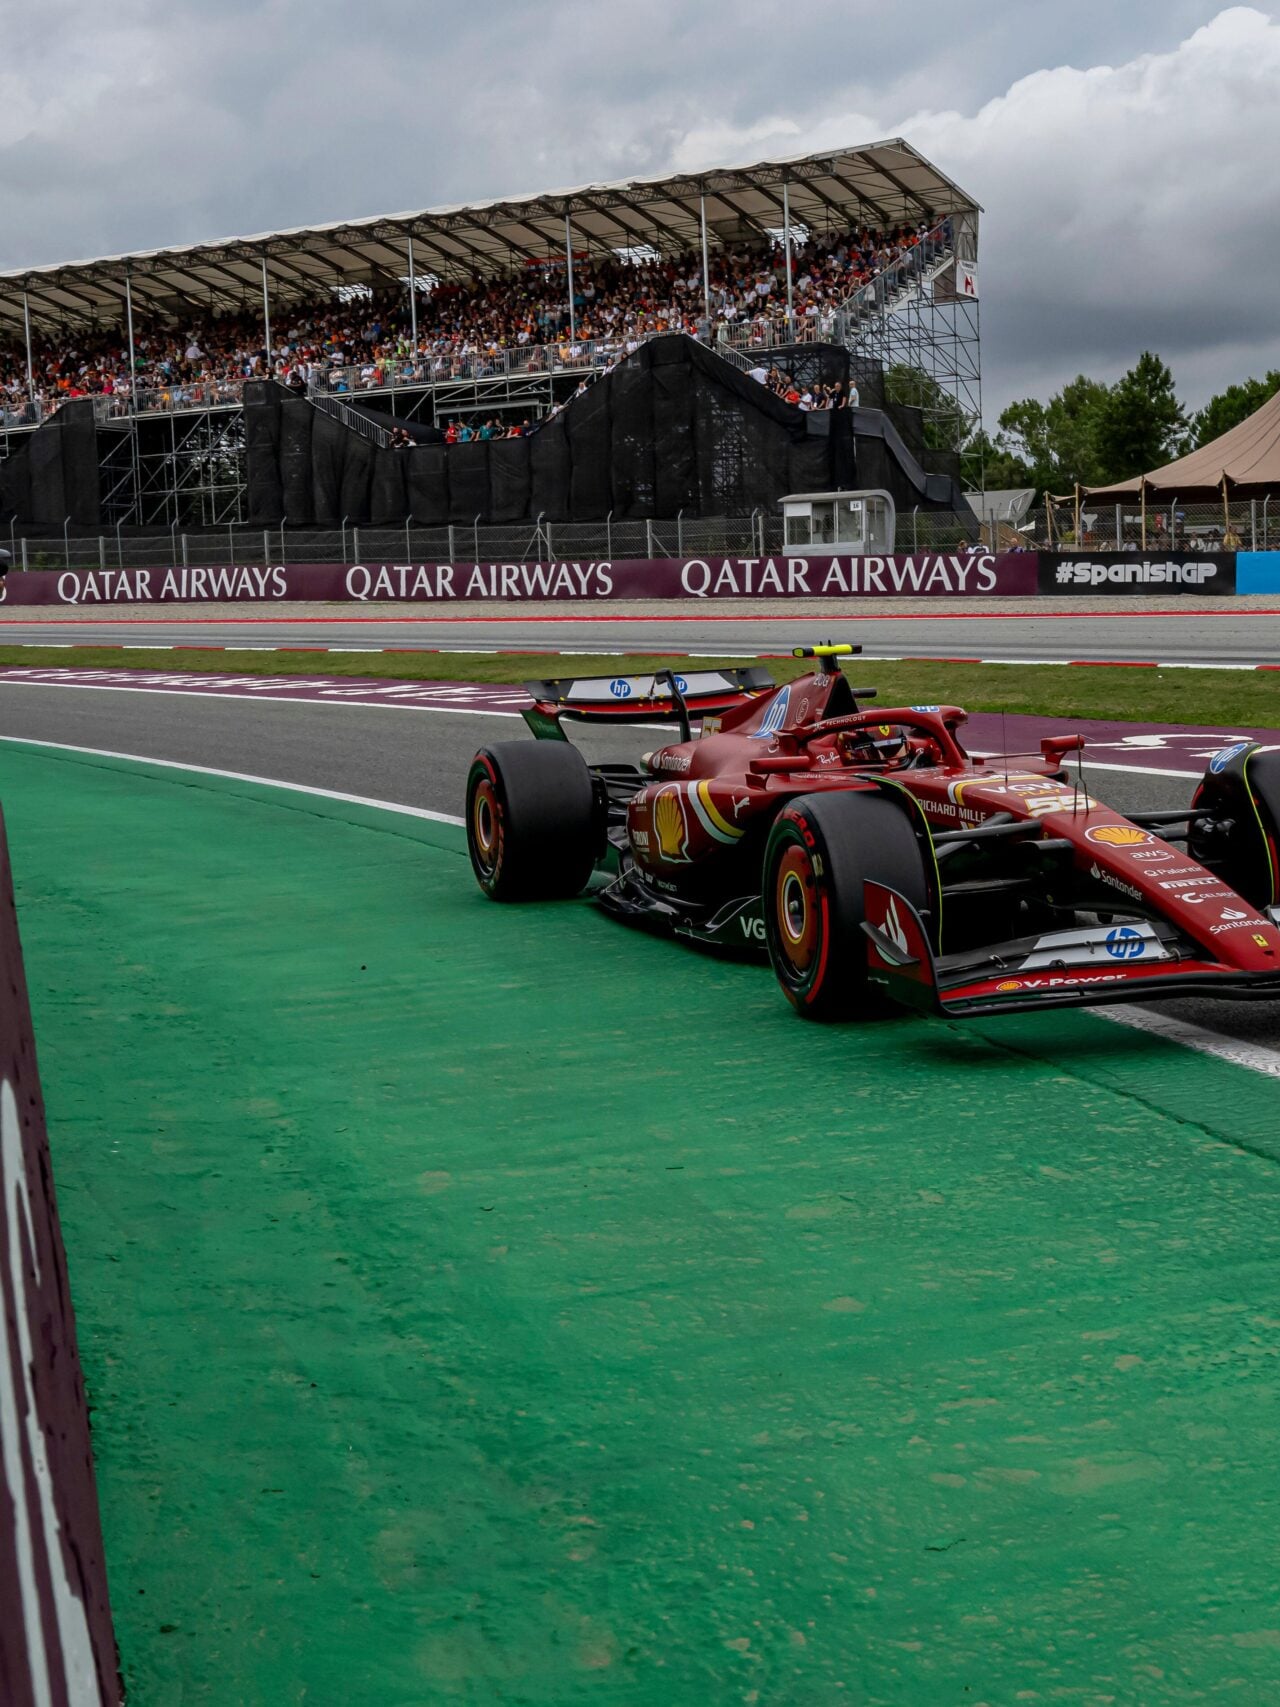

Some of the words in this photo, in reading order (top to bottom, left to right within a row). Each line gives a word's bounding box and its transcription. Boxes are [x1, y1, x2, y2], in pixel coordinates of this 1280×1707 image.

[346, 565, 454, 601] QATAR
[466, 561, 613, 597] AIRWAYS
[681, 558, 810, 598] QATAR
[822, 555, 997, 592] AIRWAYS
[1056, 561, 1218, 585] #SpanishGP
[57, 569, 152, 604] QATAR
[161, 566, 288, 601] AIRWAYS
[611, 679, 631, 698] hp
[826, 715, 867, 726] TECHNOLOGY
[980, 781, 1067, 795] VGW
[1015, 787, 1061, 797] PLAY
[918, 799, 956, 817] RICHARD
[958, 807, 987, 823] MILLE
[1024, 794, 1098, 819] 55
[1130, 849, 1169, 859] aws
[1156, 866, 1203, 876] Palantir
[1101, 869, 1143, 902] Santander
[1158, 877, 1222, 890] PIRELLI
[1110, 928, 1142, 959] hp
[1023, 973, 1128, 989] V-Power
